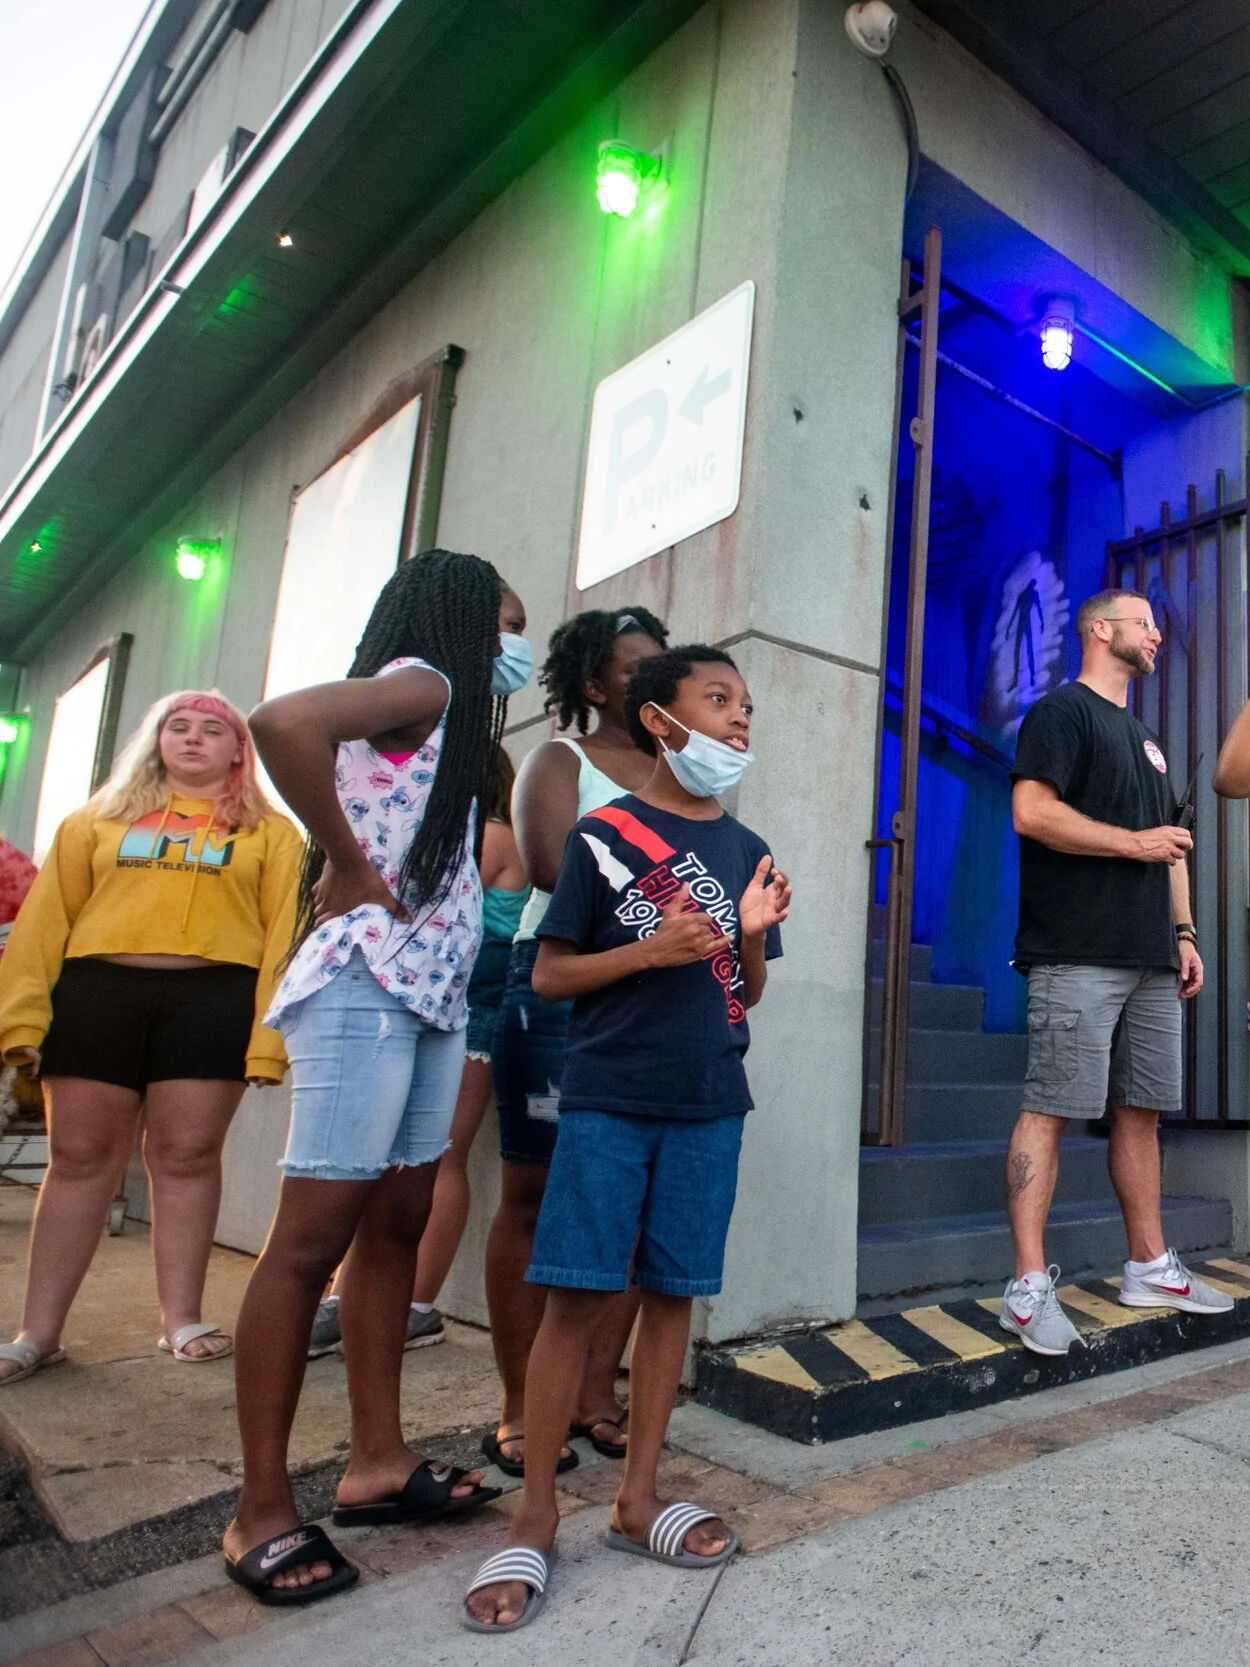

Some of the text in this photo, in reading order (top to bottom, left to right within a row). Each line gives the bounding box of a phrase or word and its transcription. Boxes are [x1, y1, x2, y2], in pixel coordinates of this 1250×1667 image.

[117, 859, 221, 876] MUSIC TELEVISION
[267, 1531, 307, 1557] NIKE
